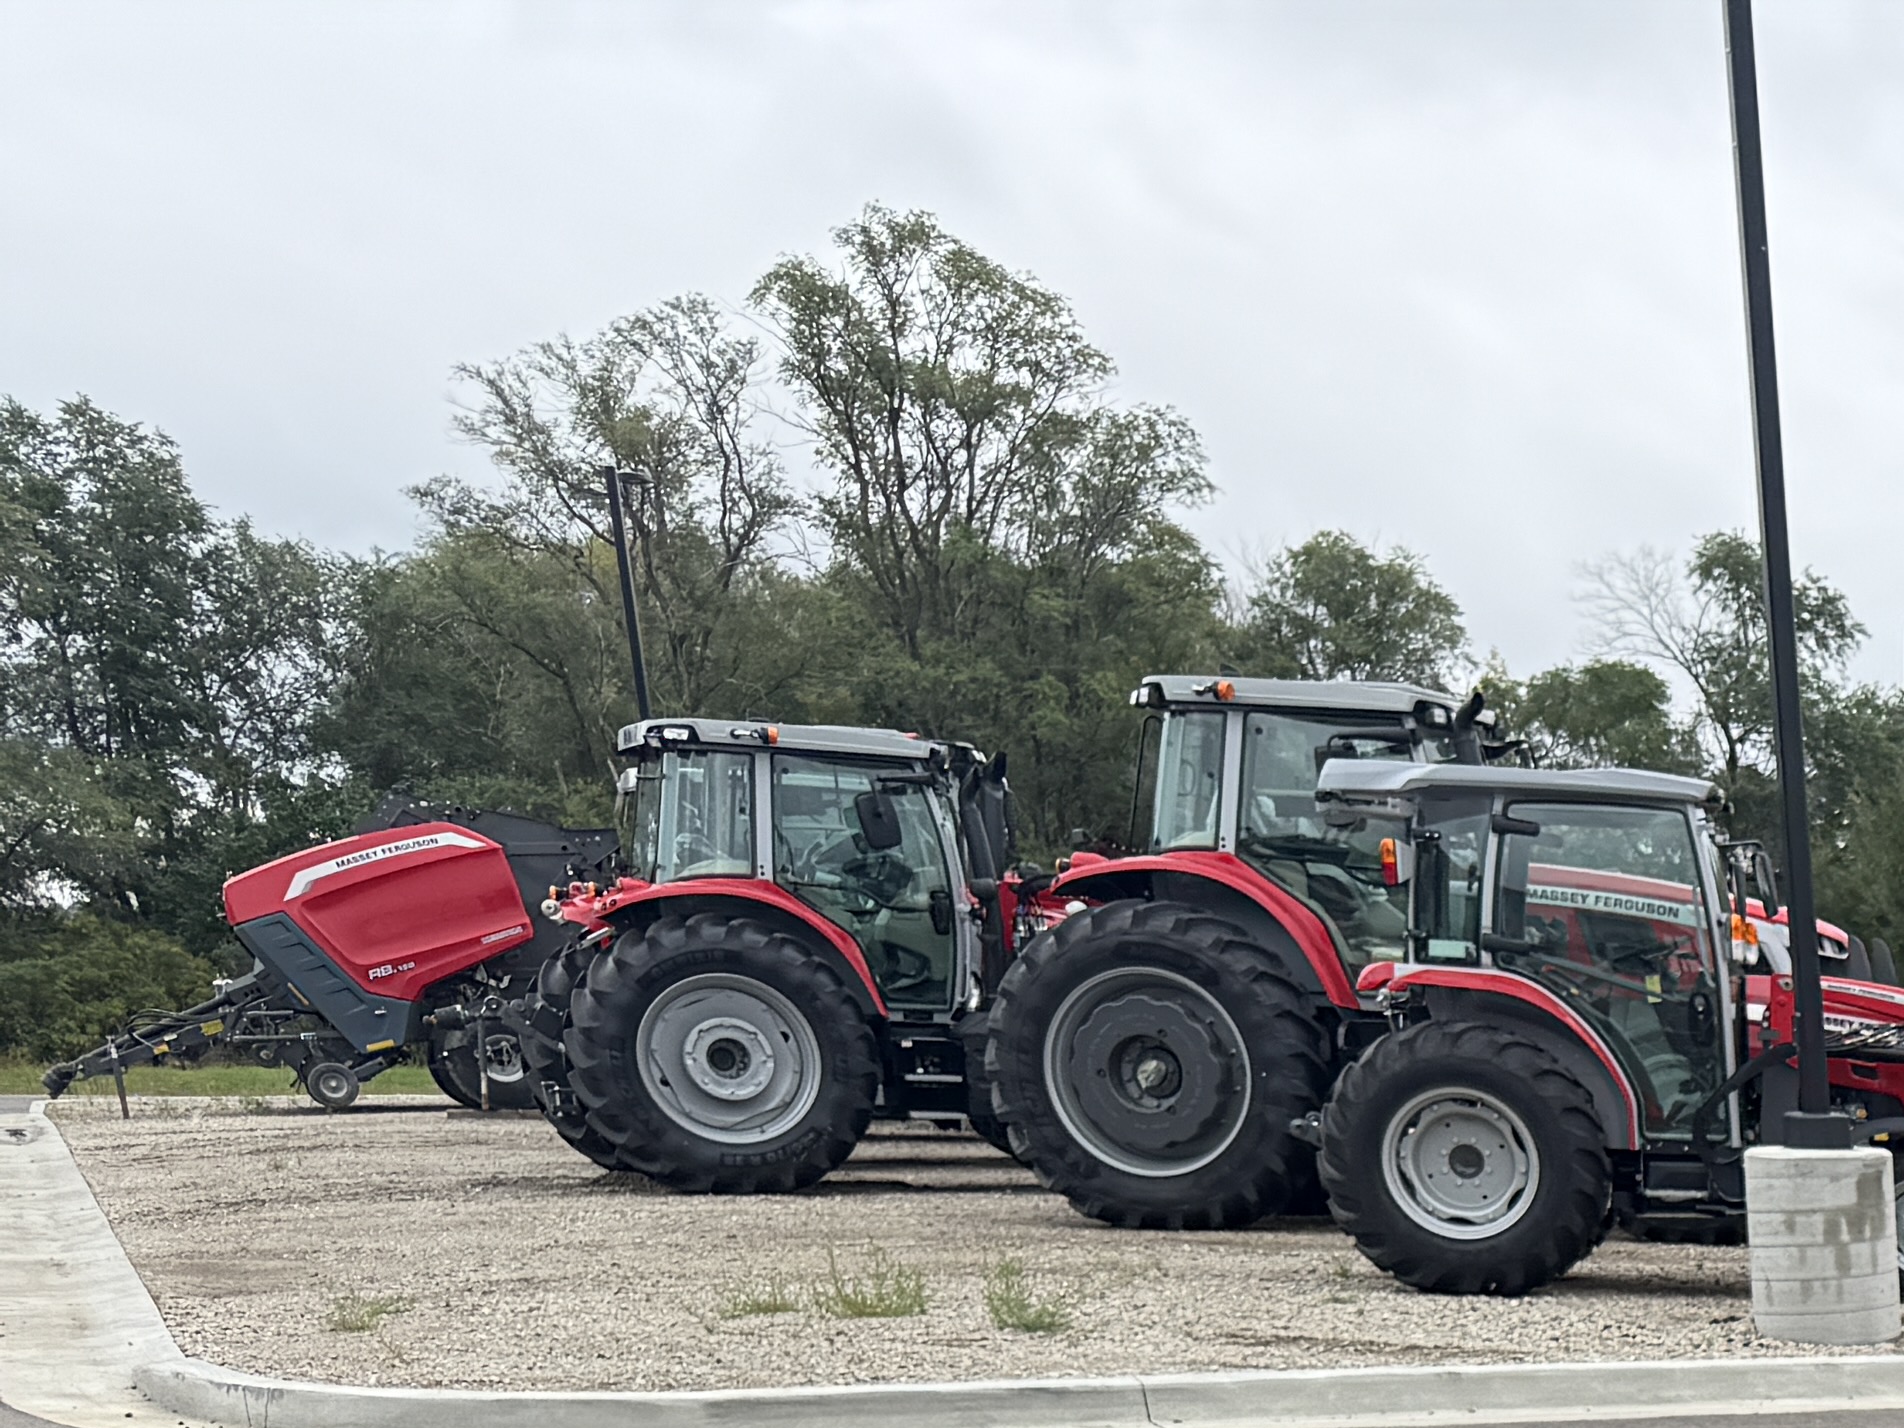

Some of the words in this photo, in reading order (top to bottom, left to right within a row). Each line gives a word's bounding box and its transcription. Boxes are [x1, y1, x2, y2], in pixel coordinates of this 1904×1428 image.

[335, 850, 378, 868] MASSEY
[381, 837, 439, 856] FERGUSON
[1526, 887, 1590, 905] MASSEY
[1594, 894, 1680, 919] FERGUSON
